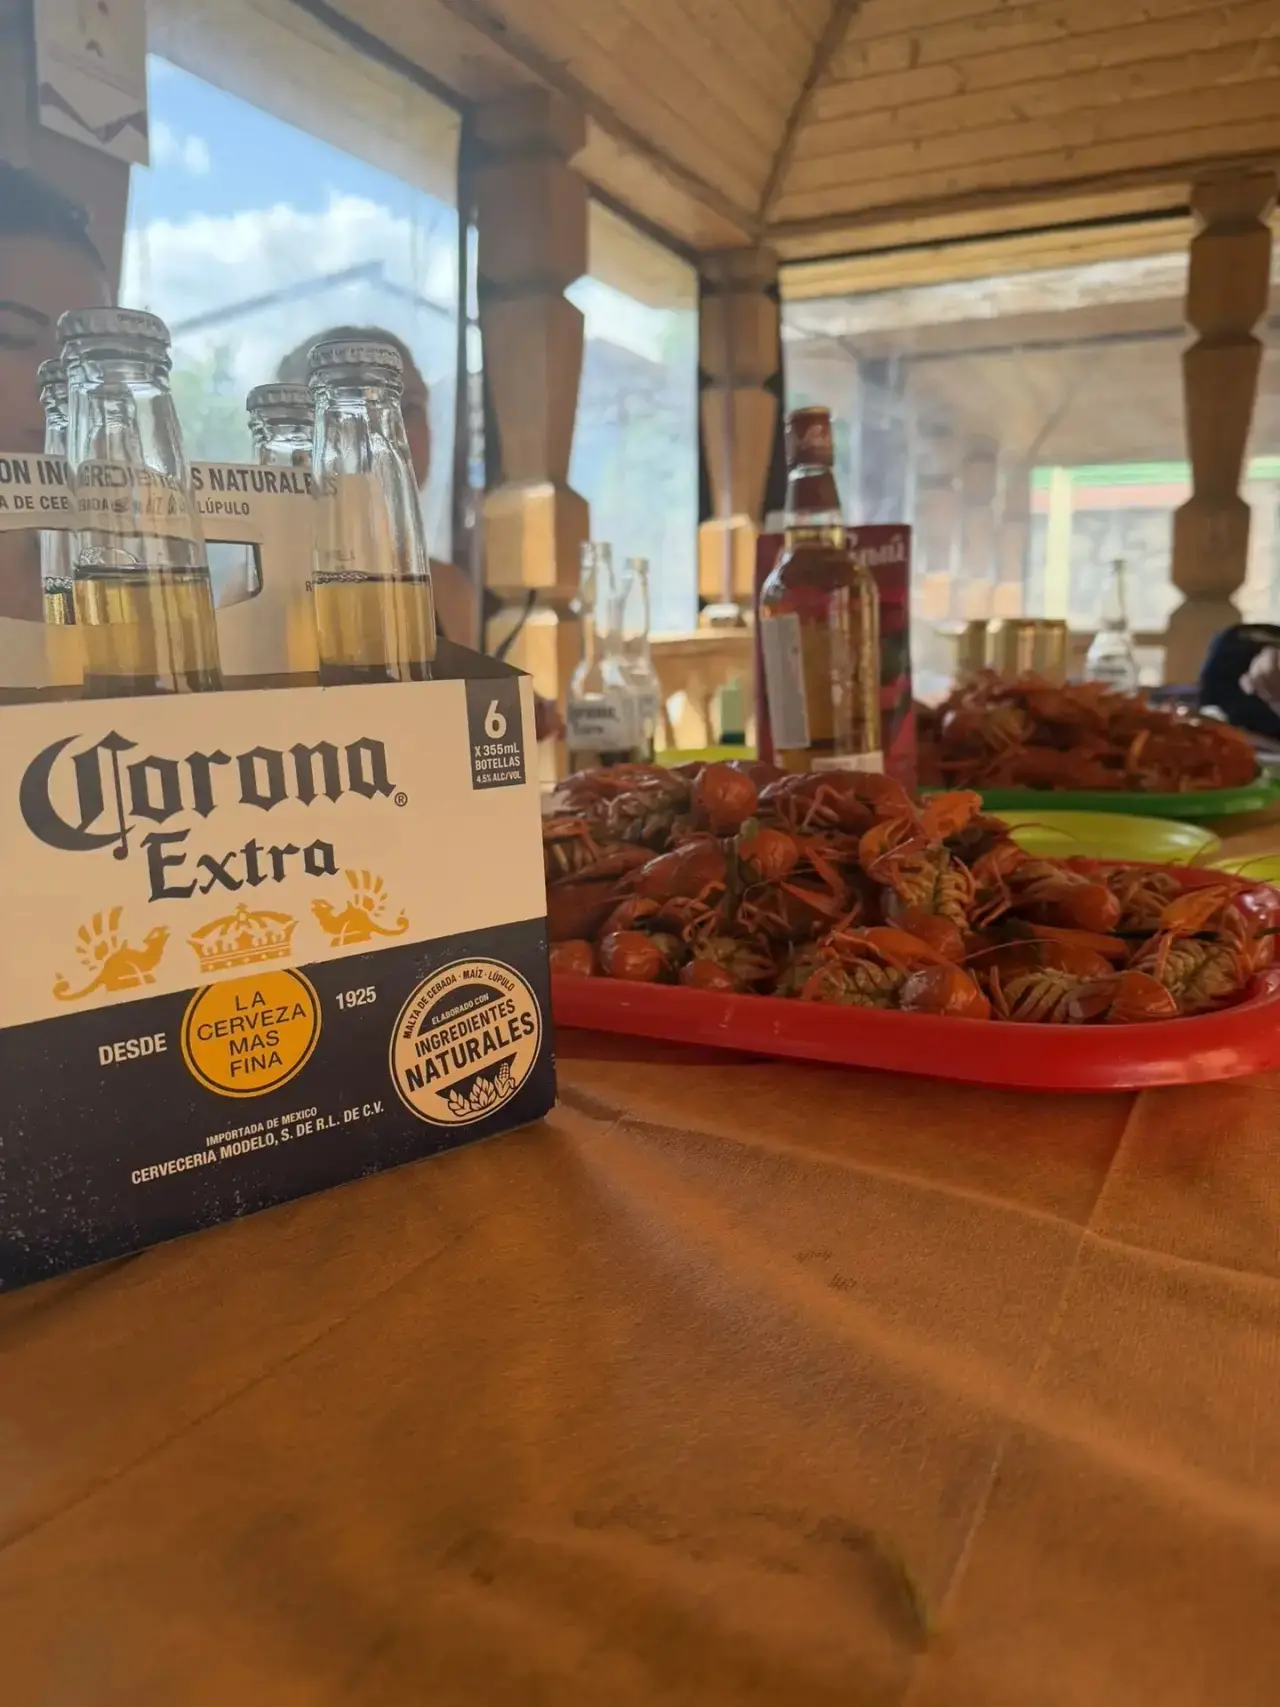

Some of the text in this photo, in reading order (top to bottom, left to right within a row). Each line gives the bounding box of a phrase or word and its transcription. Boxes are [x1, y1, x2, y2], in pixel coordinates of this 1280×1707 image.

[0, 459, 31, 484] ON
[37, 460, 204, 491] INGREDIES
[14, 495, 34, 510] DE
[199, 498, 249, 515] LÚPULO
[485, 700, 507, 739] 6
[475, 756, 521, 770] BOTELLAS
[483, 742, 520, 756] 355mL
[493, 771, 521, 782] ALC/VOL
[19, 730, 396, 860] Corona
[140, 828, 340, 902] Extra
[234, 991, 267, 1012] LA
[335, 986, 377, 1010] 1925
[403, 967, 516, 1039] MALTA DE CEBADA MAÍZ LÚPULO
[431, 993, 489, 1025] ELABORADO CON
[197, 1003, 307, 1041] CERVEZA
[415, 999, 516, 1057] INGREDIENTES
[99, 1033, 168, 1066] DESDE
[229, 1030, 280, 1056] MAS
[404, 1012, 535, 1092] NATURALES
[229, 1051, 283, 1078] FINA
[131, 1101, 385, 1184] CERVECERIA MODELO, S. DE R.L. DE C.V.
[206, 1107, 318, 1147] IMPORTADA DE MEXICO
